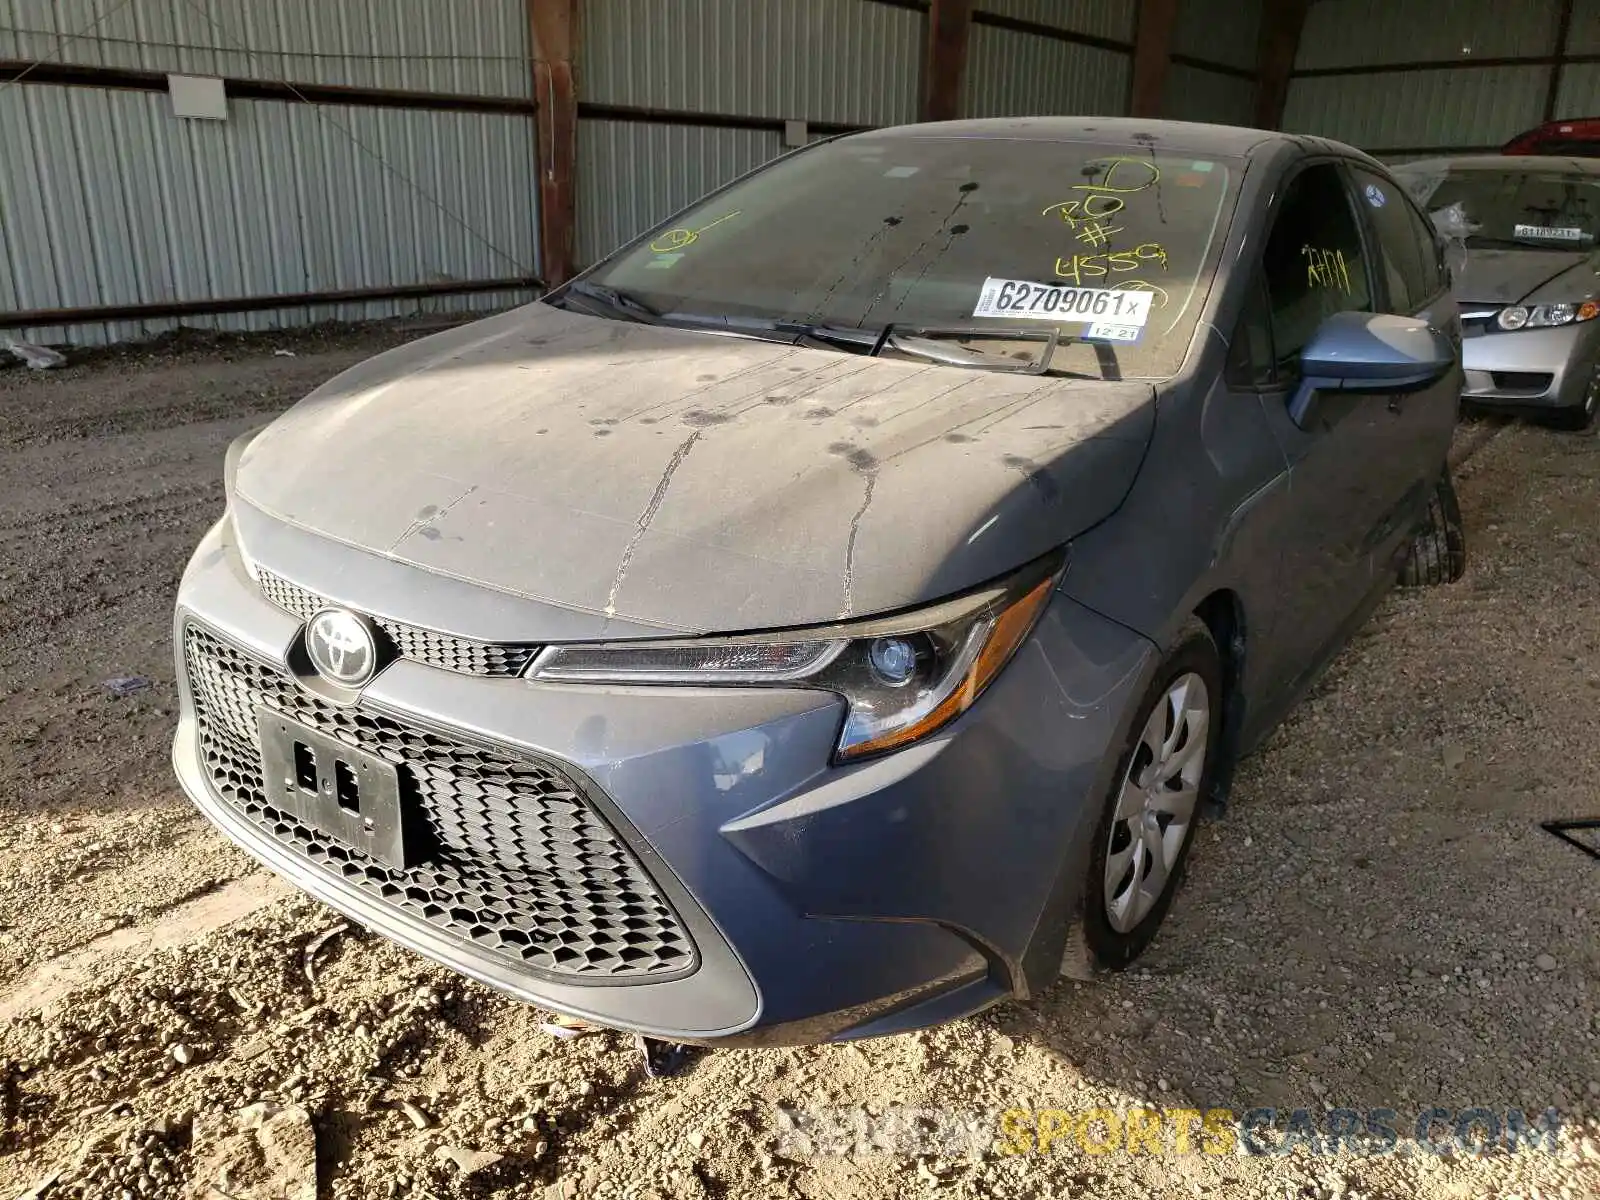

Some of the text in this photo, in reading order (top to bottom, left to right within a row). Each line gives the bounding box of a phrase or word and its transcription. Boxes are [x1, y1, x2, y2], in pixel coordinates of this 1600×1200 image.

[996, 280, 1126, 317] 62709061
[1094, 327, 1136, 339] 12 21
